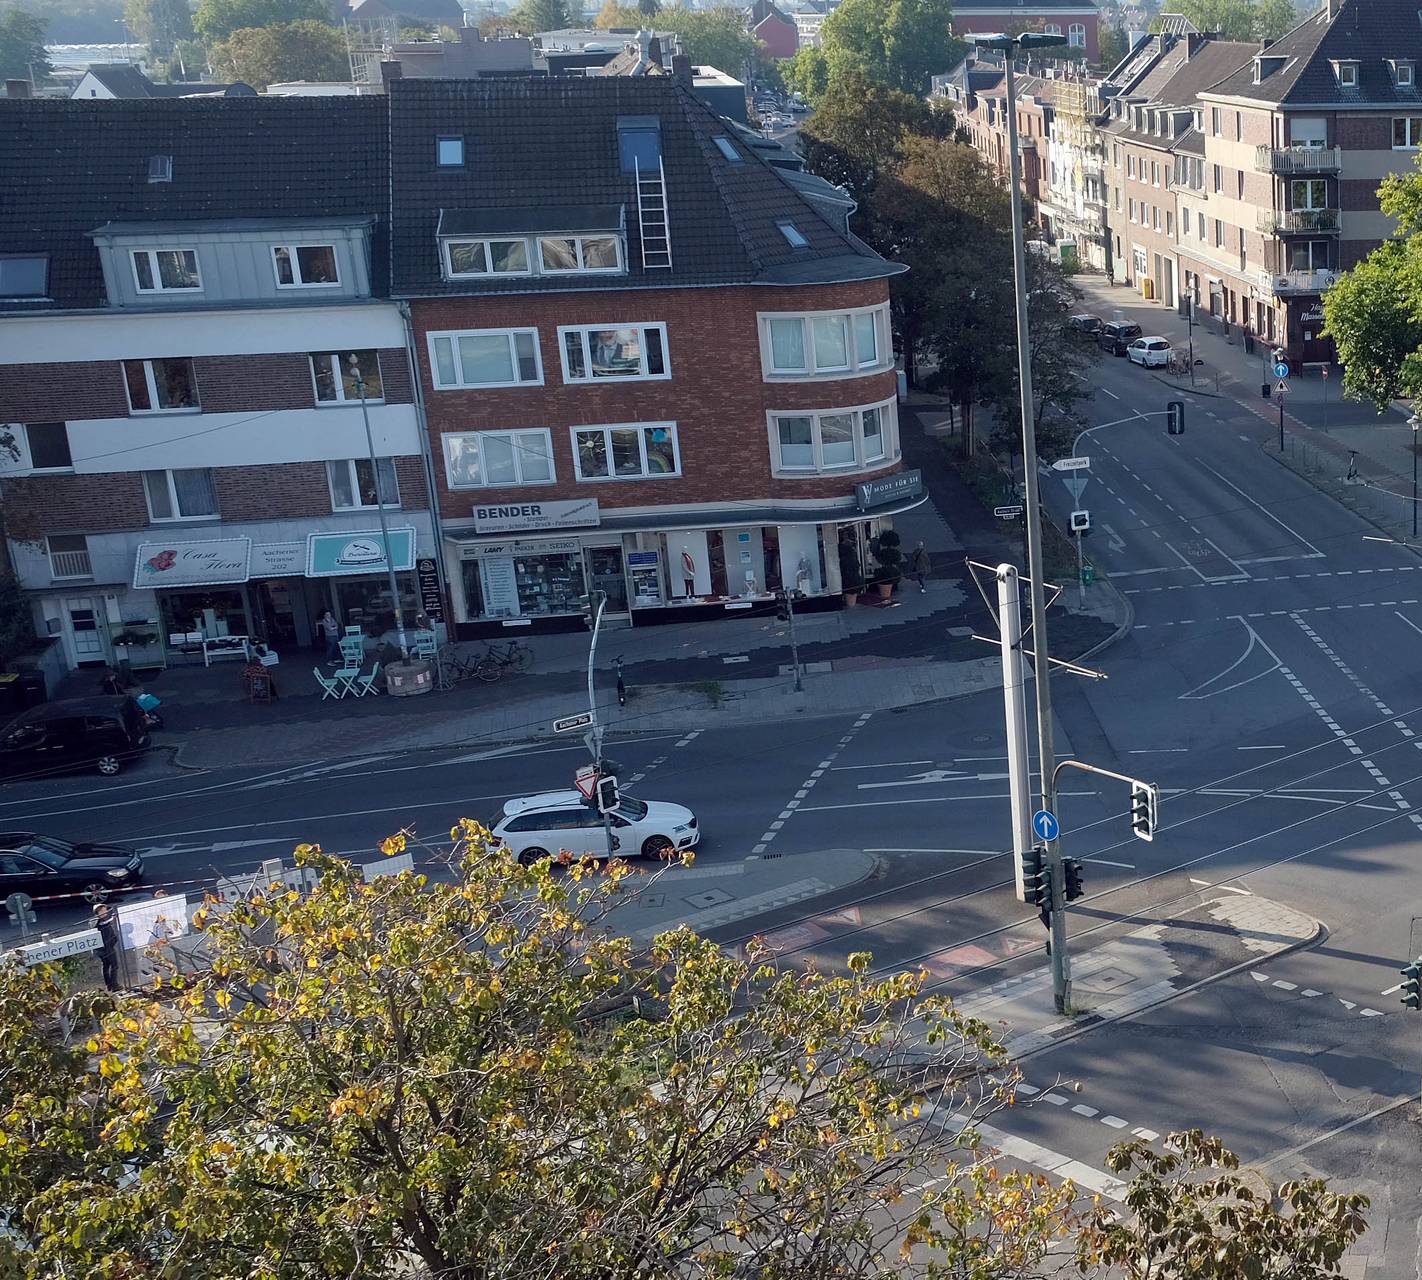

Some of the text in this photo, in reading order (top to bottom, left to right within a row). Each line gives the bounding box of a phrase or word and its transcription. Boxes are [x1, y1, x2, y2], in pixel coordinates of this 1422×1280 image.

[874, 483, 892, 493] MODE
[895, 479, 907, 488] FÜR
[477, 505, 542, 519] BENDER
[549, 541, 575, 550] SEIKO
[182, 549, 218, 560] Casa
[263, 549, 299, 557] Aachener
[200, 559, 243, 571] Flora
[271, 563, 288, 571] 202
[26, 938, 98, 962] hener Platz
